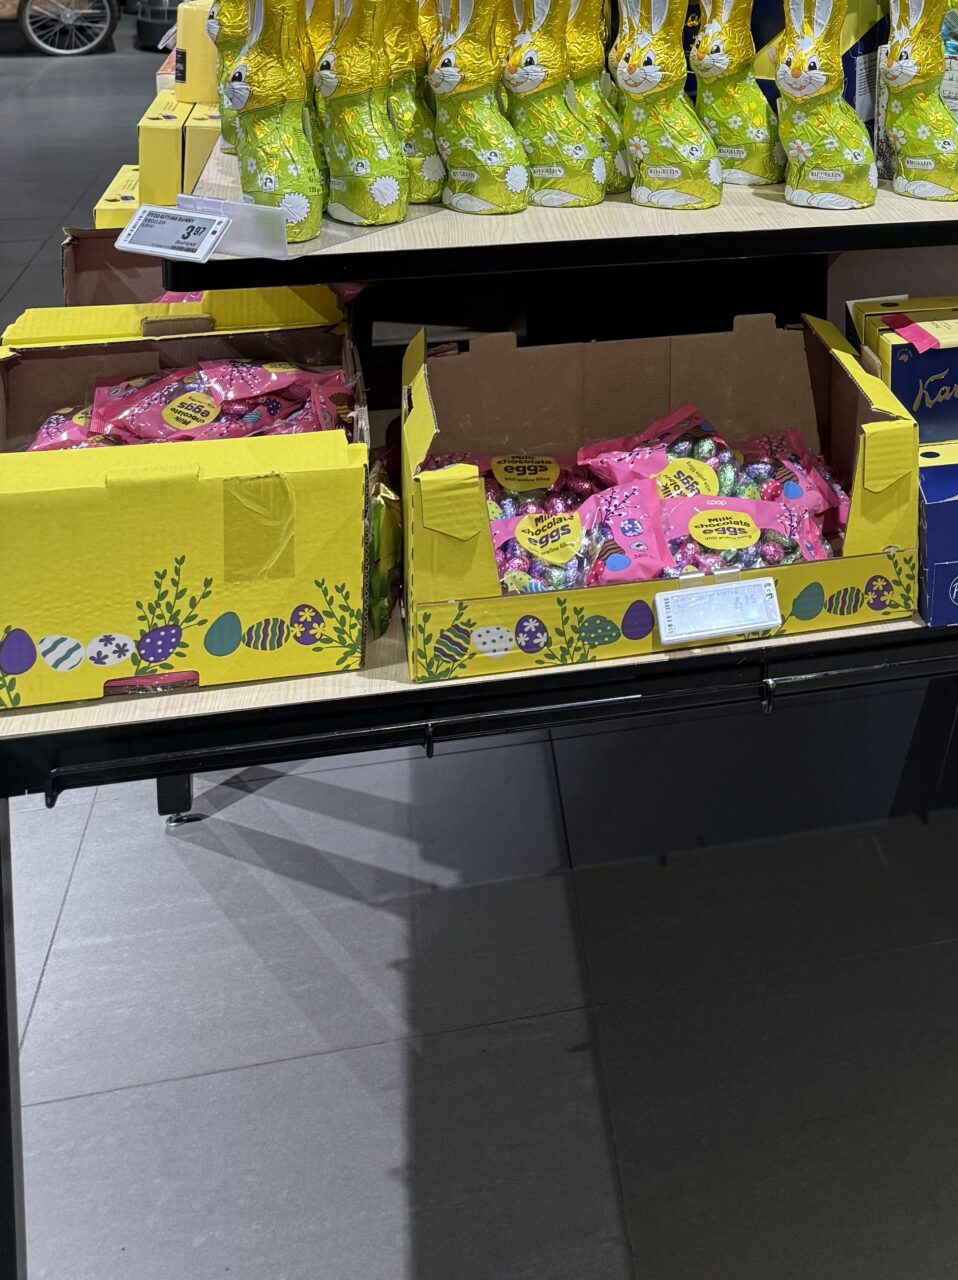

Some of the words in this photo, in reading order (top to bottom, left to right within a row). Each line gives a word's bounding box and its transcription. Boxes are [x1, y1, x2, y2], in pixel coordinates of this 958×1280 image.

[504, 464, 549, 475] eggs
[694, 521, 750, 529] chocolate
[528, 523, 571, 548] eggs
[702, 526, 748, 536] eggs
